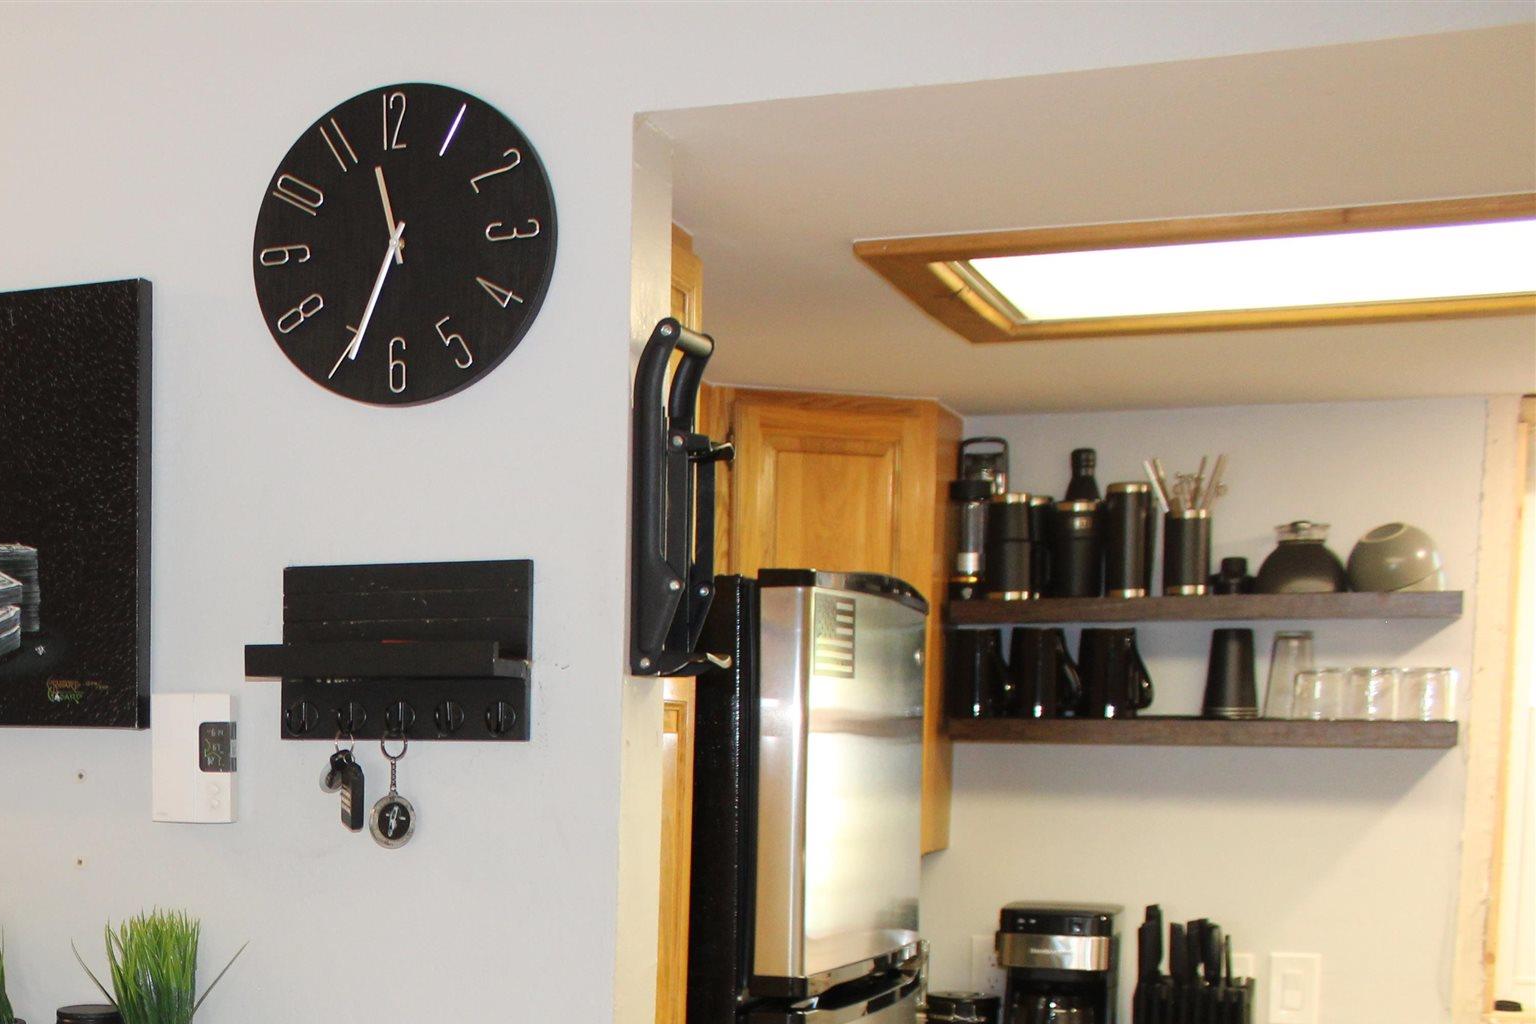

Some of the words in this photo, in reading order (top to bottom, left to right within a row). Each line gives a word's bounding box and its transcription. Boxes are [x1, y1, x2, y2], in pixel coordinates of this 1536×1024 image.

[319, 117, 358, 172] 11
[382, 91, 407, 151] 12
[439, 103, 467, 157] 1
[272, 173, 324, 216] 10
[470, 148, 522, 194] 2
[260, 244, 311, 266] 9
[485, 218, 540, 242] 3
[277, 293, 324, 334] 8
[475, 275, 524, 309] 4
[328, 324, 360, 379] 7
[389, 336, 406, 393] 6
[435, 315, 473, 369] 5
